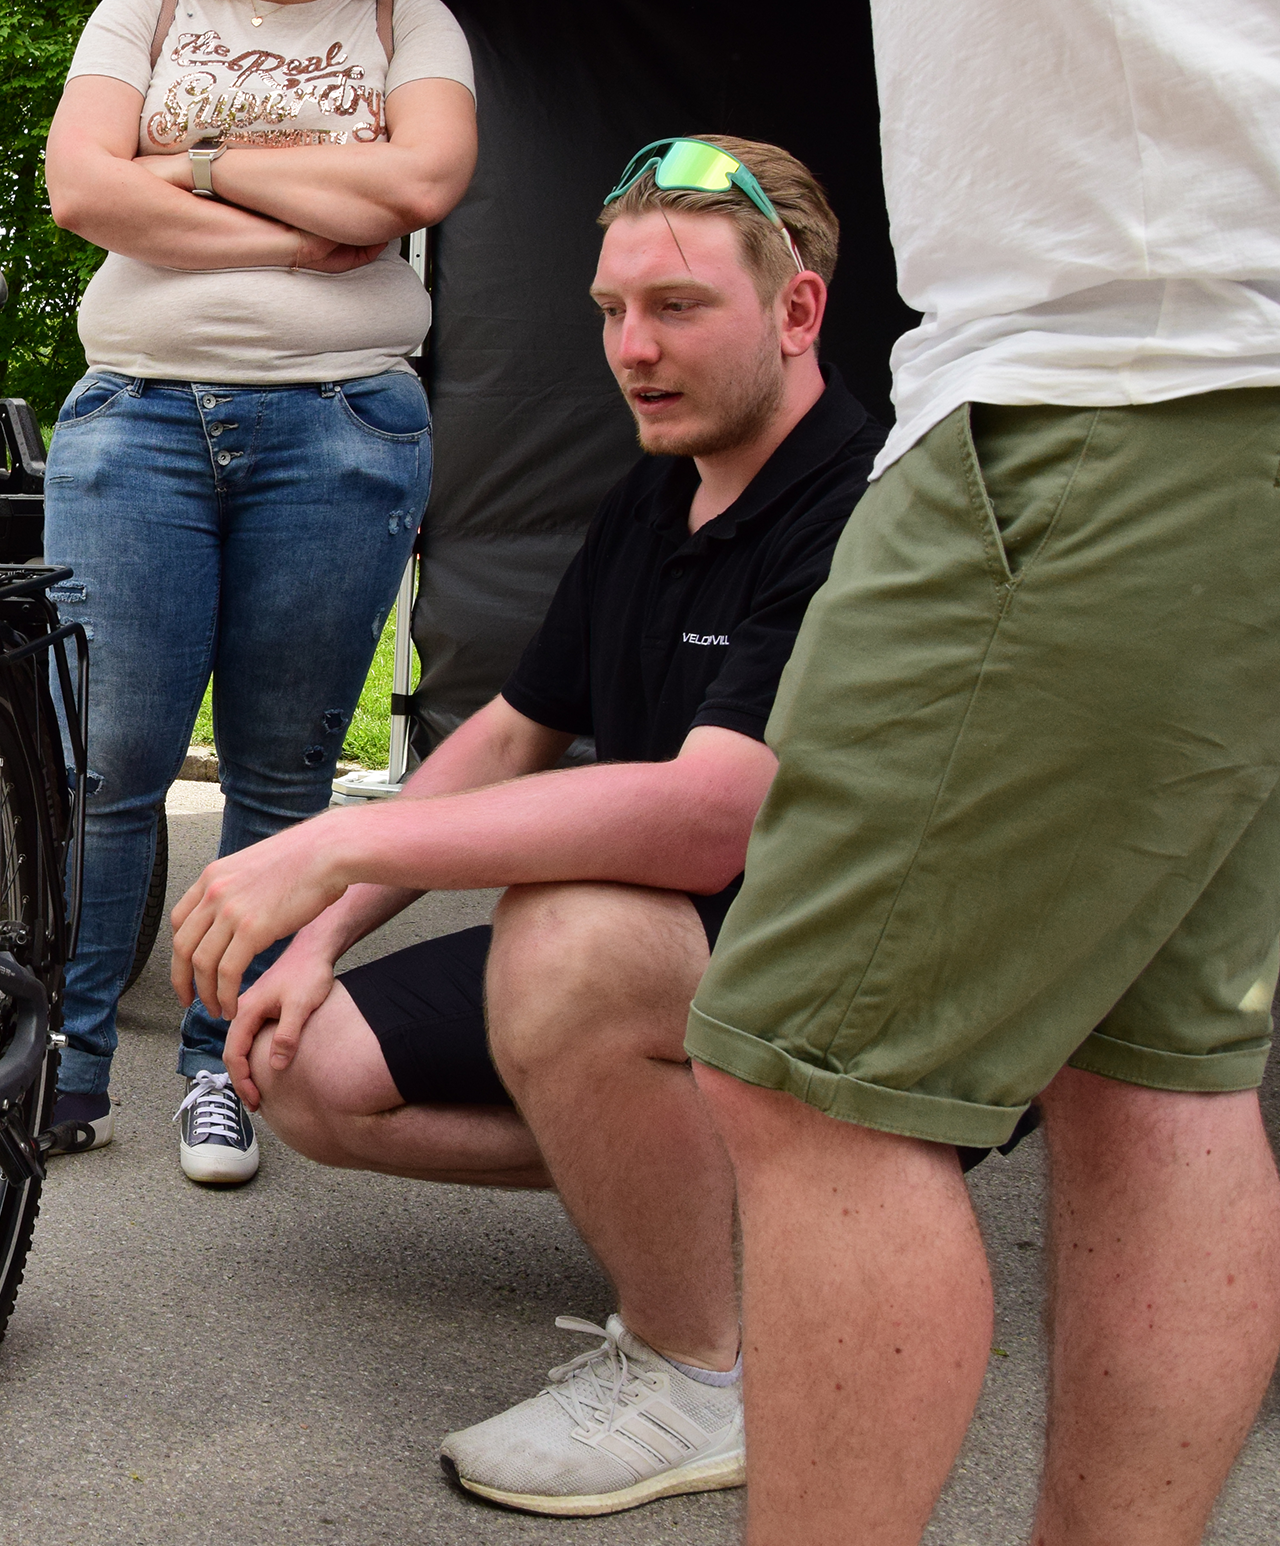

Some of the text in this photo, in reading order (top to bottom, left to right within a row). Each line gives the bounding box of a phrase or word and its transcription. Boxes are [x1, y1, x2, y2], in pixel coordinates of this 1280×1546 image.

[170, 30, 231, 61] The
[223, 41, 348, 90] Real
[147, 65, 387, 148] Superdry
